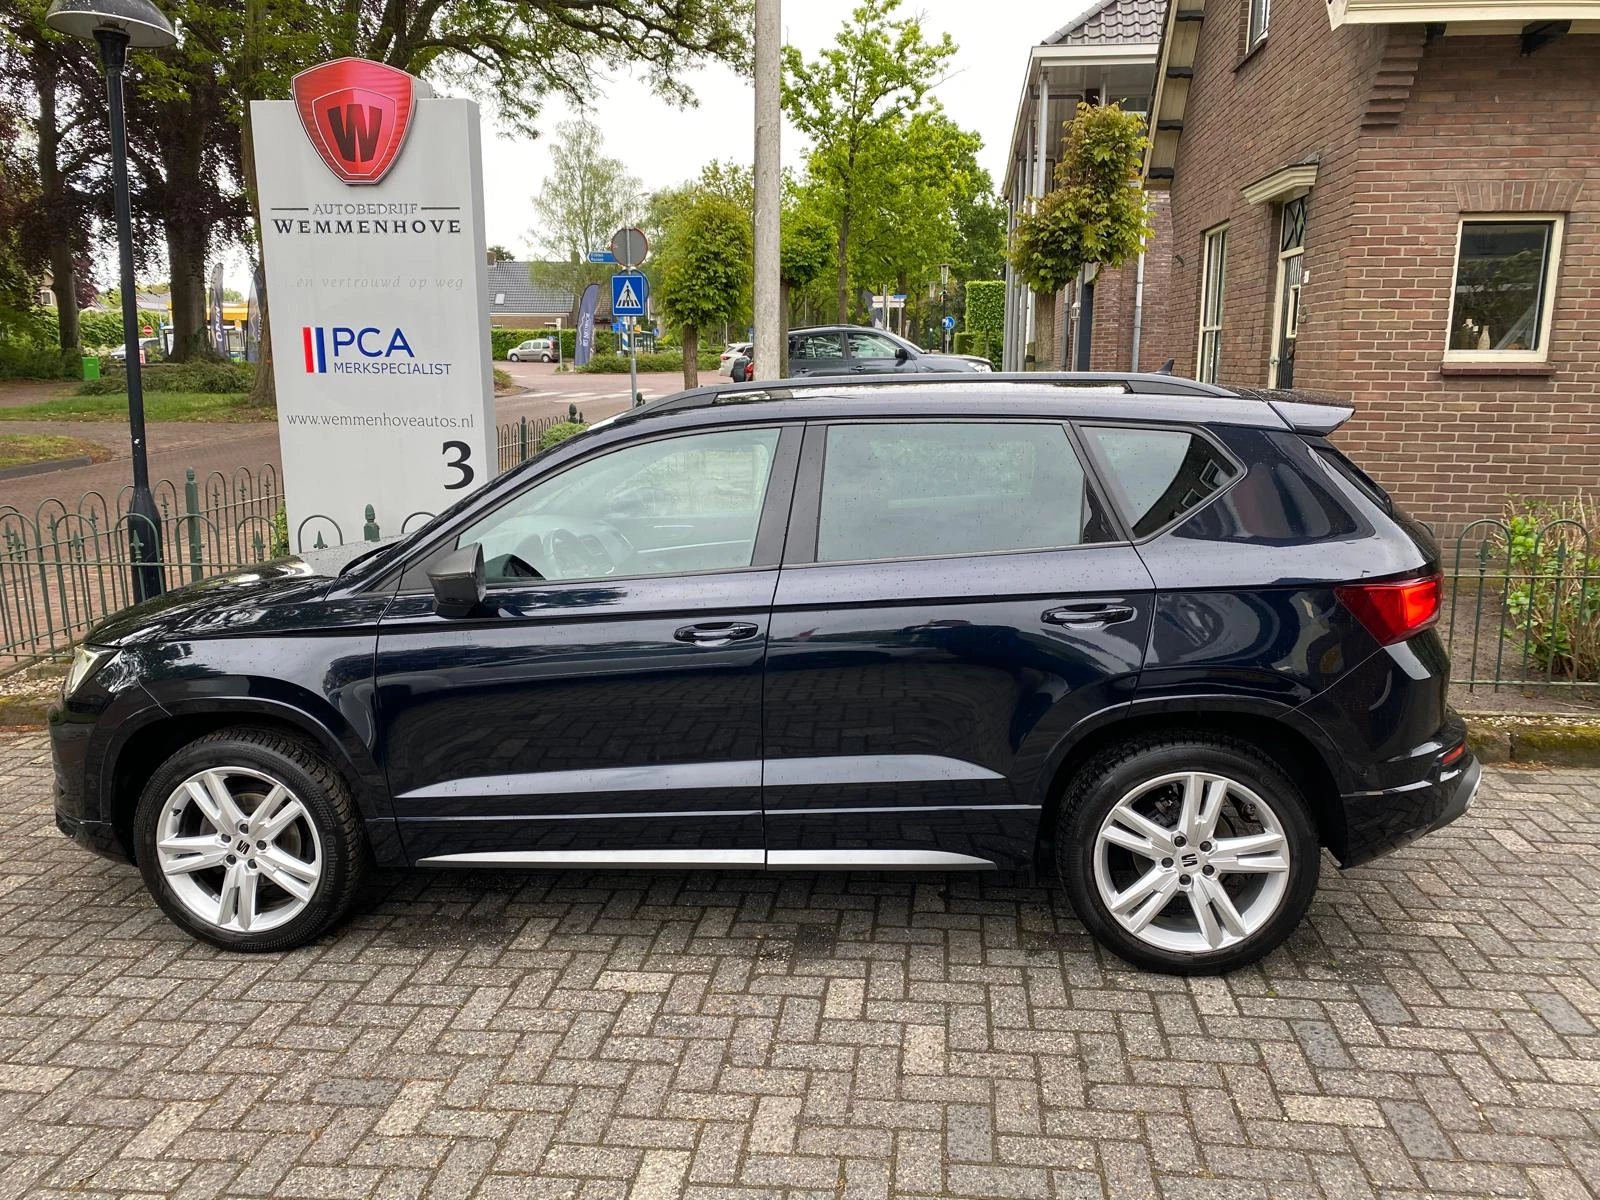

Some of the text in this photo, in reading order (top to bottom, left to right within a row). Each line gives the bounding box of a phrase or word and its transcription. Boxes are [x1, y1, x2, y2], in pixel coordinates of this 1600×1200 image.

[327, 104, 383, 163] W
[312, 203, 418, 216] AUTOBEDRIJF
[271, 218, 461, 235] WEMMENHOVE
[322, 275, 401, 289] vertrouwd
[409, 278, 427, 290] op
[435, 278, 463, 291] weg
[332, 327, 415, 358] PCA
[333, 361, 452, 376] MERKSPECIALIST
[286, 412, 474, 428] www.wemmenhoveautos.nl
[442, 440, 475, 490] 3
